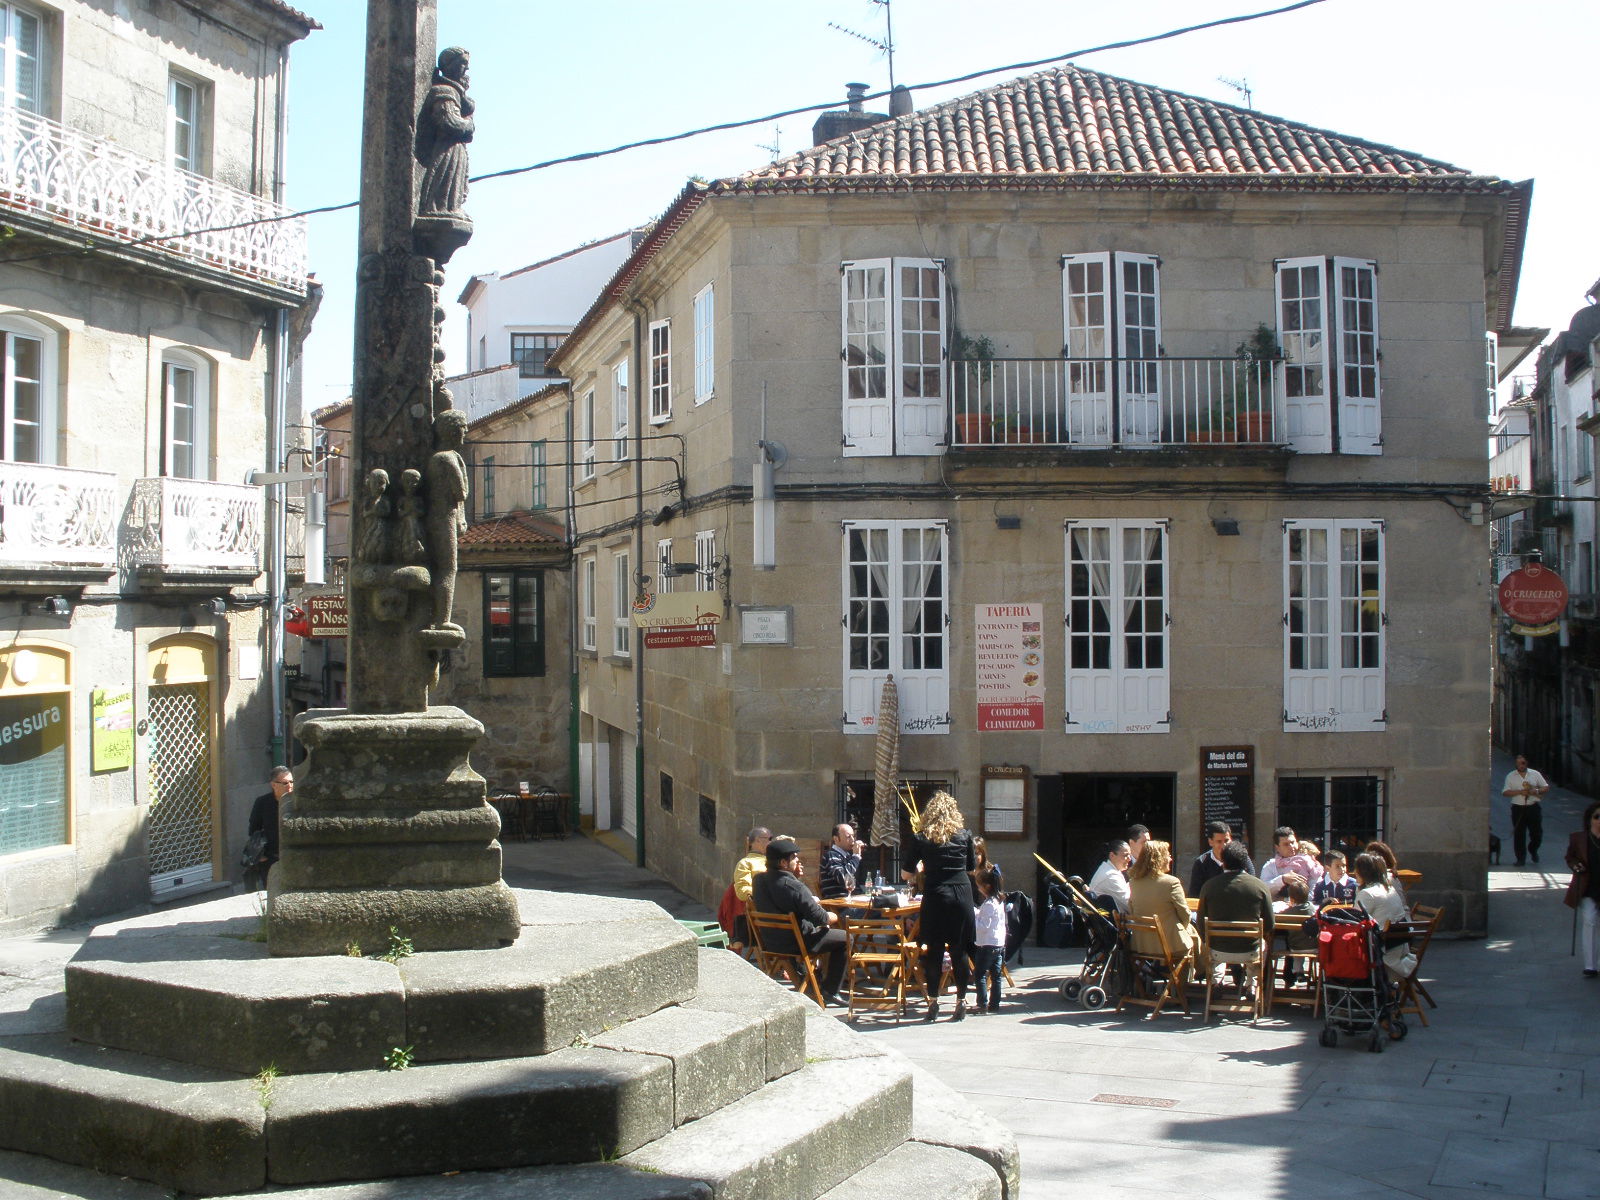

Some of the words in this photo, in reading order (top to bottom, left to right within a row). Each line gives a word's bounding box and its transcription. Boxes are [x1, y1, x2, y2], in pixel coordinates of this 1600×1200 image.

[1504, 590, 1512, 598] O
[1513, 590, 1562, 599] CRUCEIRO
[312, 600, 347, 609] RESTAU
[640, 618, 648, 627] O
[649, 616, 692, 626] CRUCEIRO
[647, 636, 685, 644] restaurante
[690, 632, 714, 644] tapería
[990, 708, 1030, 717] COMEDOR
[985, 720, 1036, 729] CLIMATIZADO
